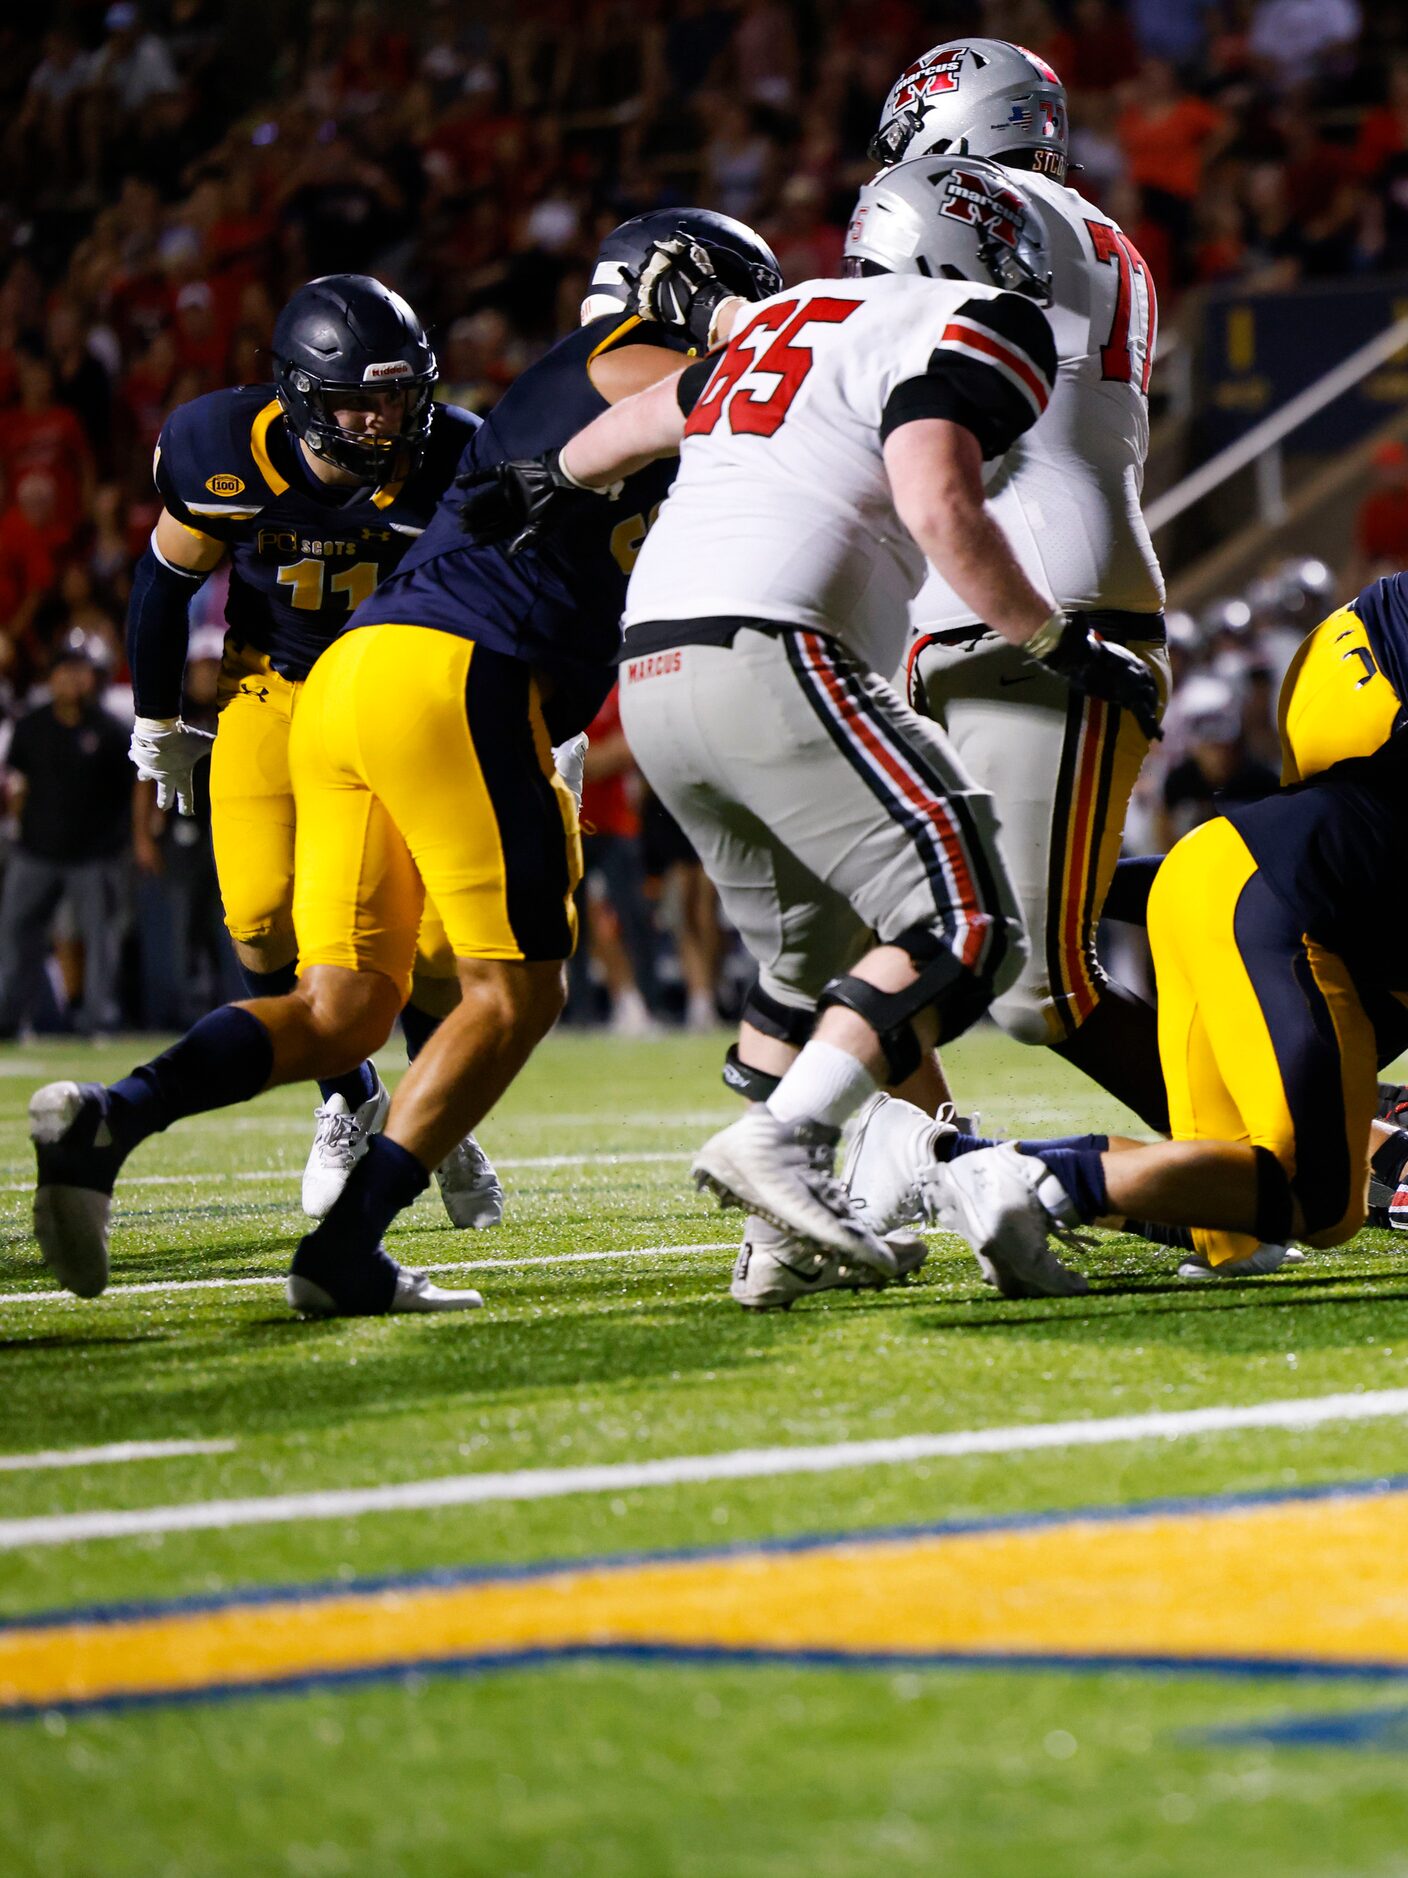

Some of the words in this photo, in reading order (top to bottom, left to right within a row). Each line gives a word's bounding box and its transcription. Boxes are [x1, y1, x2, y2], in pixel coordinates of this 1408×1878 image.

[894, 61, 959, 94] marcus
[948, 184, 1024, 228] marcus
[684, 296, 867, 440] 65
[215, 481, 236, 491] 100
[301, 539, 357, 556] SCOTS
[277, 558, 379, 611] 11
